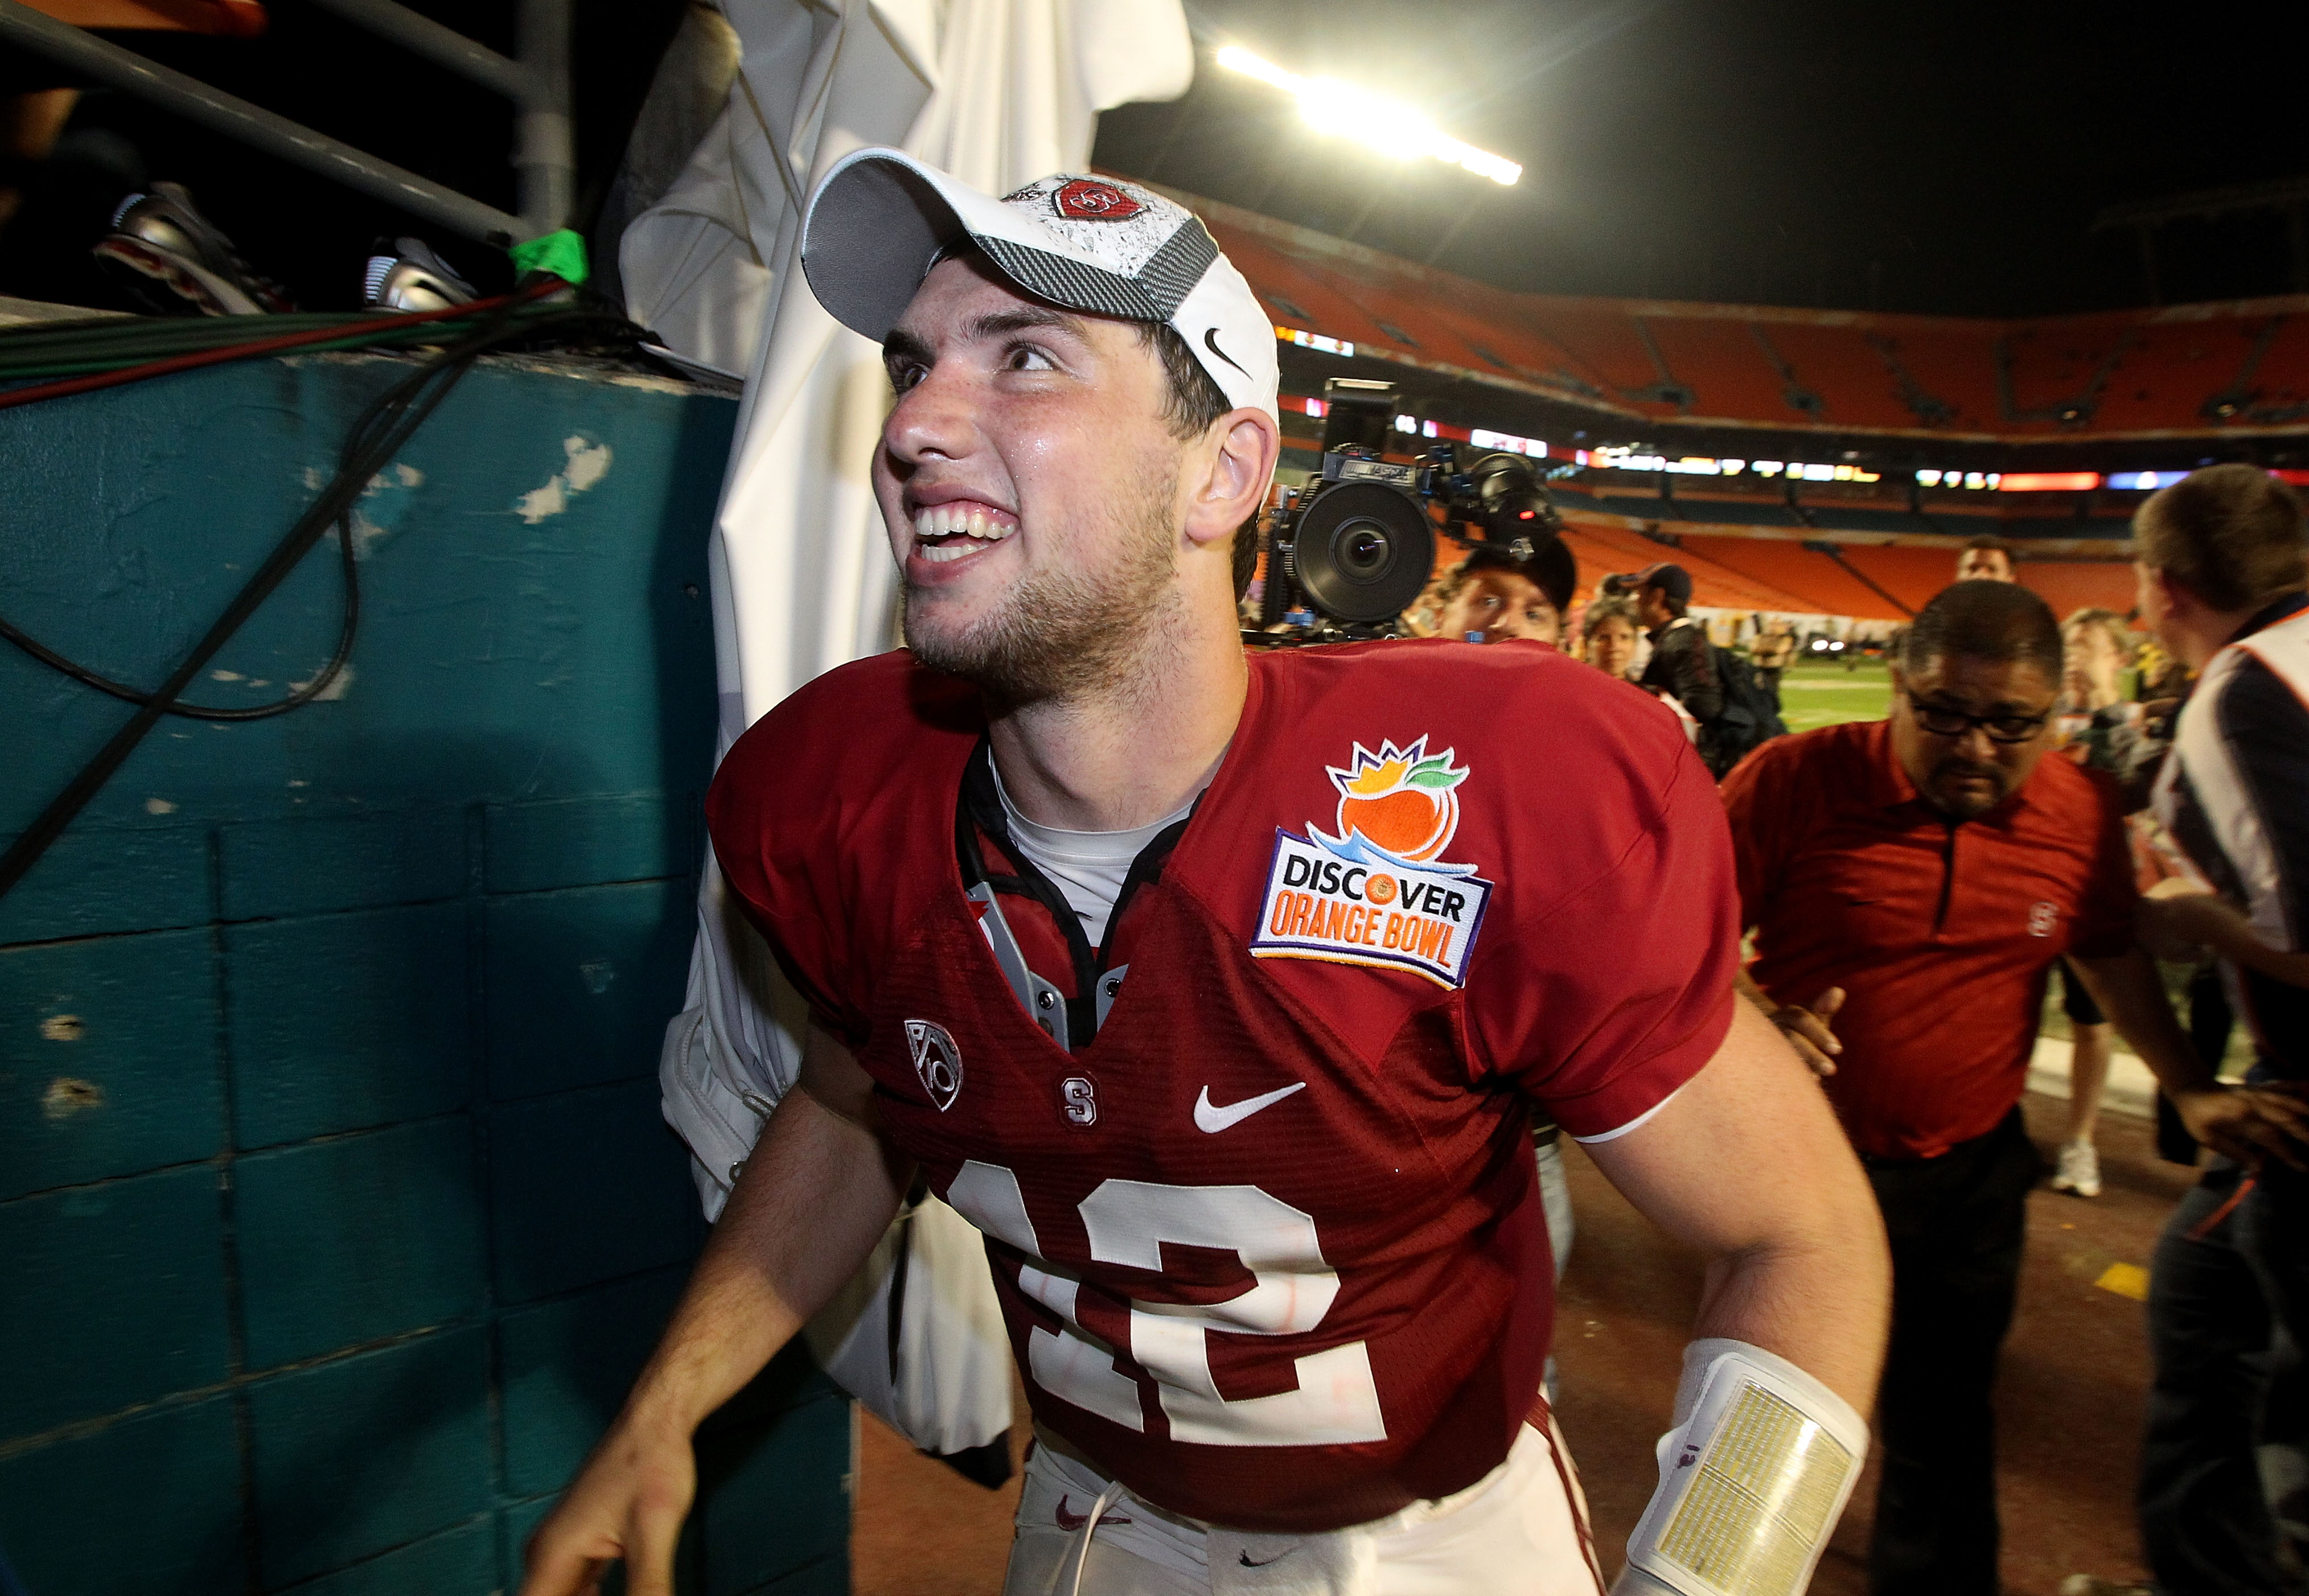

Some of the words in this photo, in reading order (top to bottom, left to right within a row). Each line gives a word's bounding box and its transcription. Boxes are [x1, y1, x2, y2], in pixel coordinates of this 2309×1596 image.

[1284, 854, 1465, 922] DISCOVER
[1271, 890, 1382, 945] ORANGE
[1383, 912, 1455, 968] BOWL
[1061, 1077, 1096, 1126] S
[947, 1159, 1388, 1446] 12
